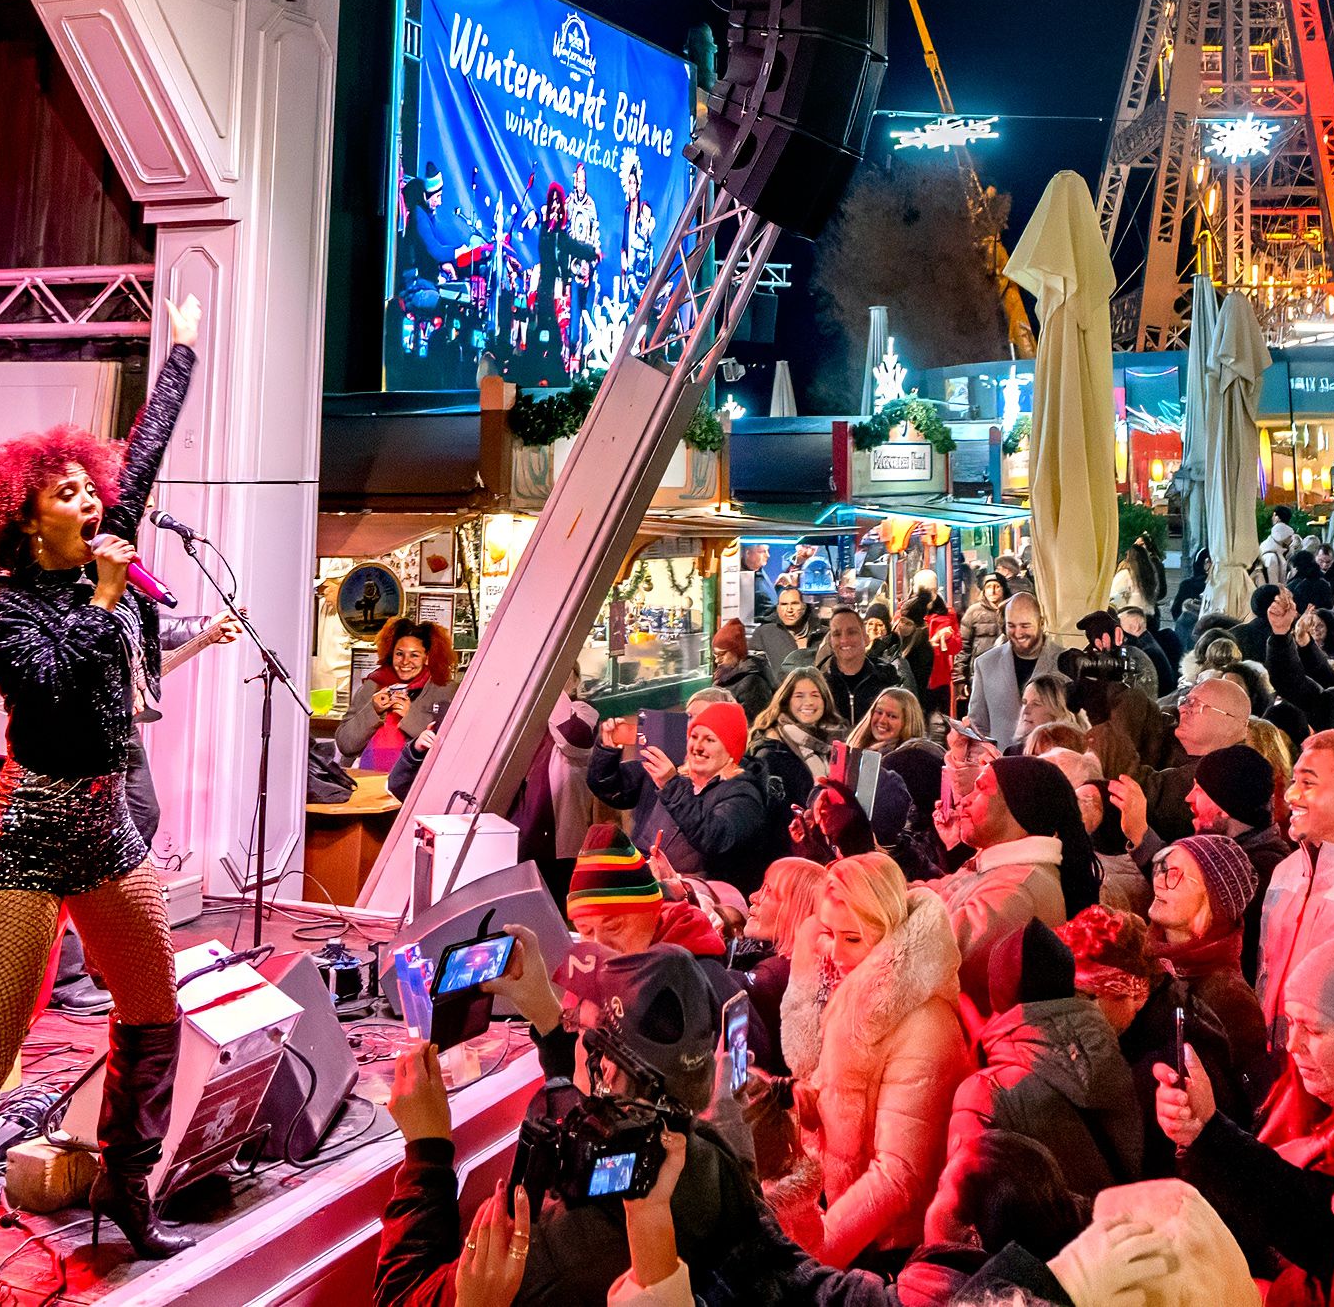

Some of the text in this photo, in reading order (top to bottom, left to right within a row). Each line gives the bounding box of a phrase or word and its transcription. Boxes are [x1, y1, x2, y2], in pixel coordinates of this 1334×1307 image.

[449, 12, 674, 158] Wintermarkt Bühne
[505, 106, 619, 174] wintermarkt.at
